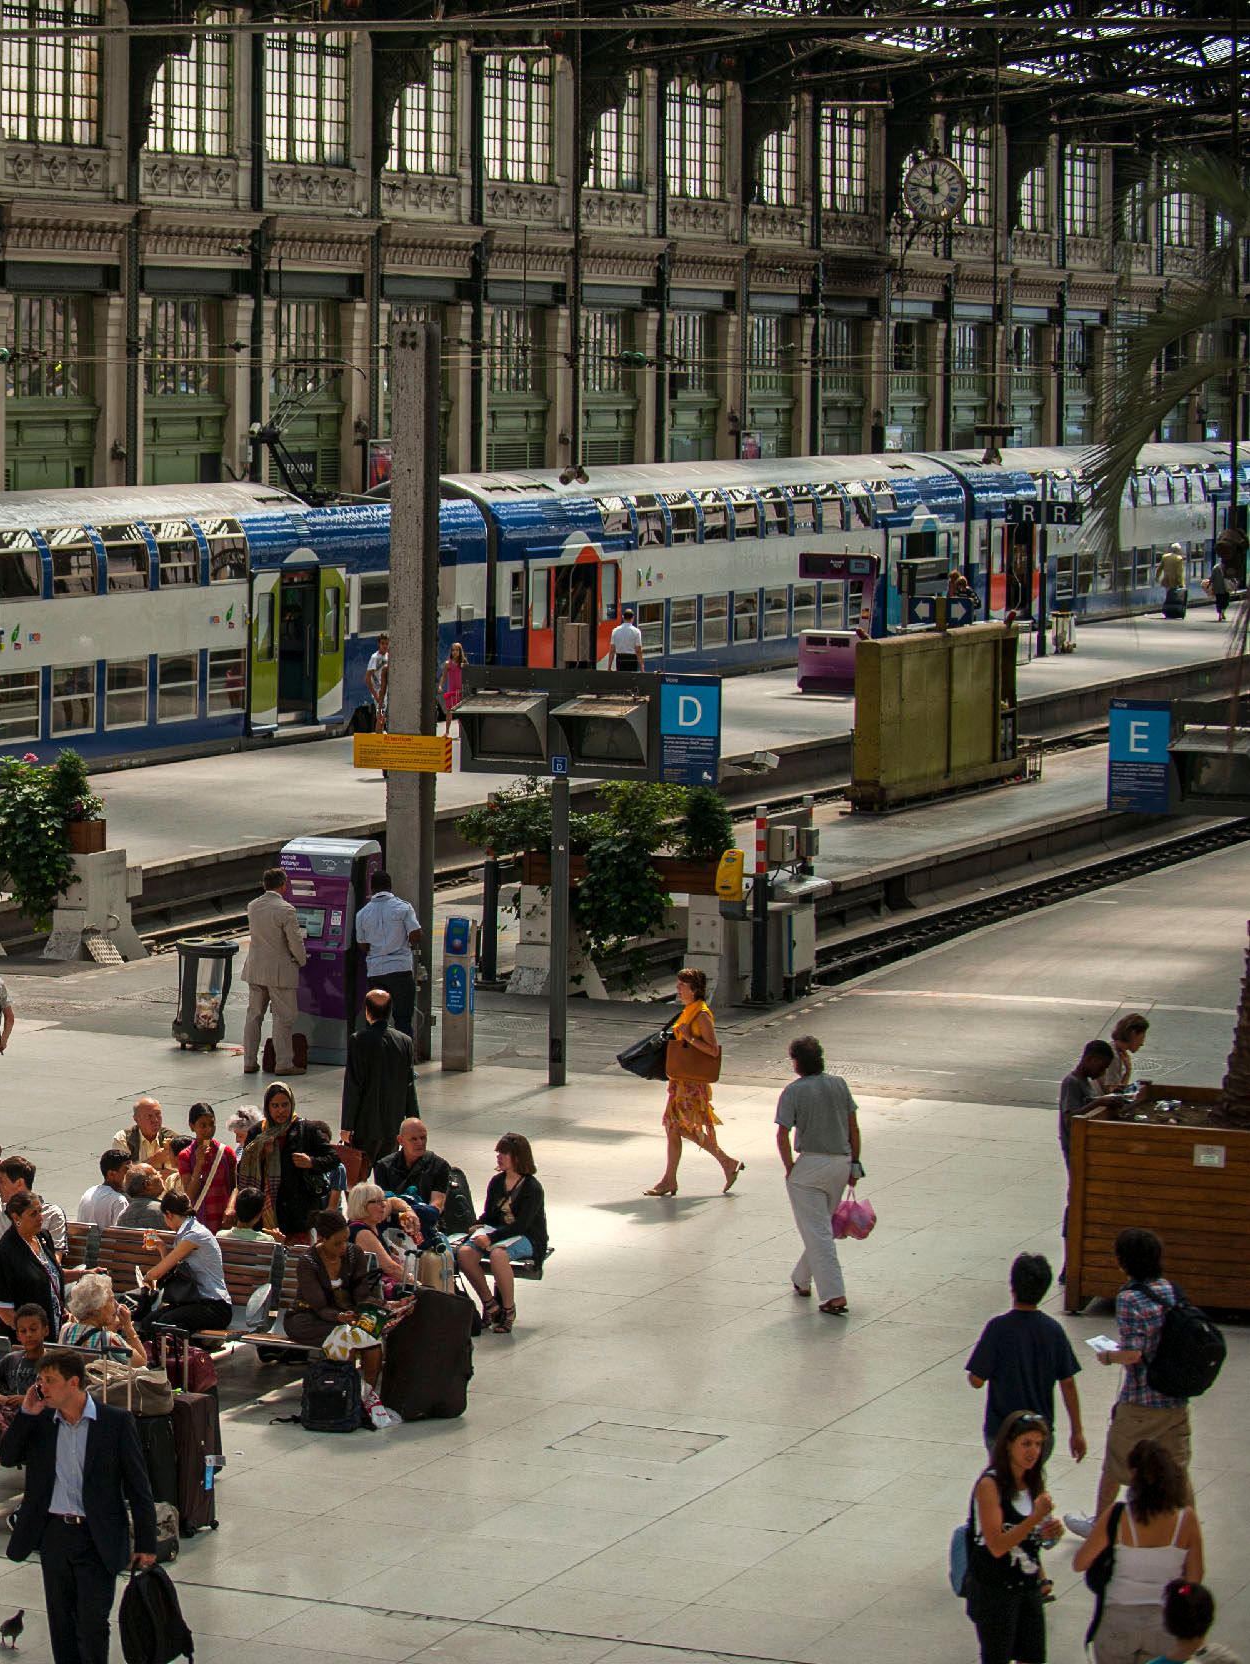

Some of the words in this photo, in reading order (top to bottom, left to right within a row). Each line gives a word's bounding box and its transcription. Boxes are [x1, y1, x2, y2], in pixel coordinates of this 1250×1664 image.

[1022, 505, 1034, 521] R
[1054, 506, 1067, 522] R
[678, 696, 702, 726] D
[1130, 721, 1149, 752] E
